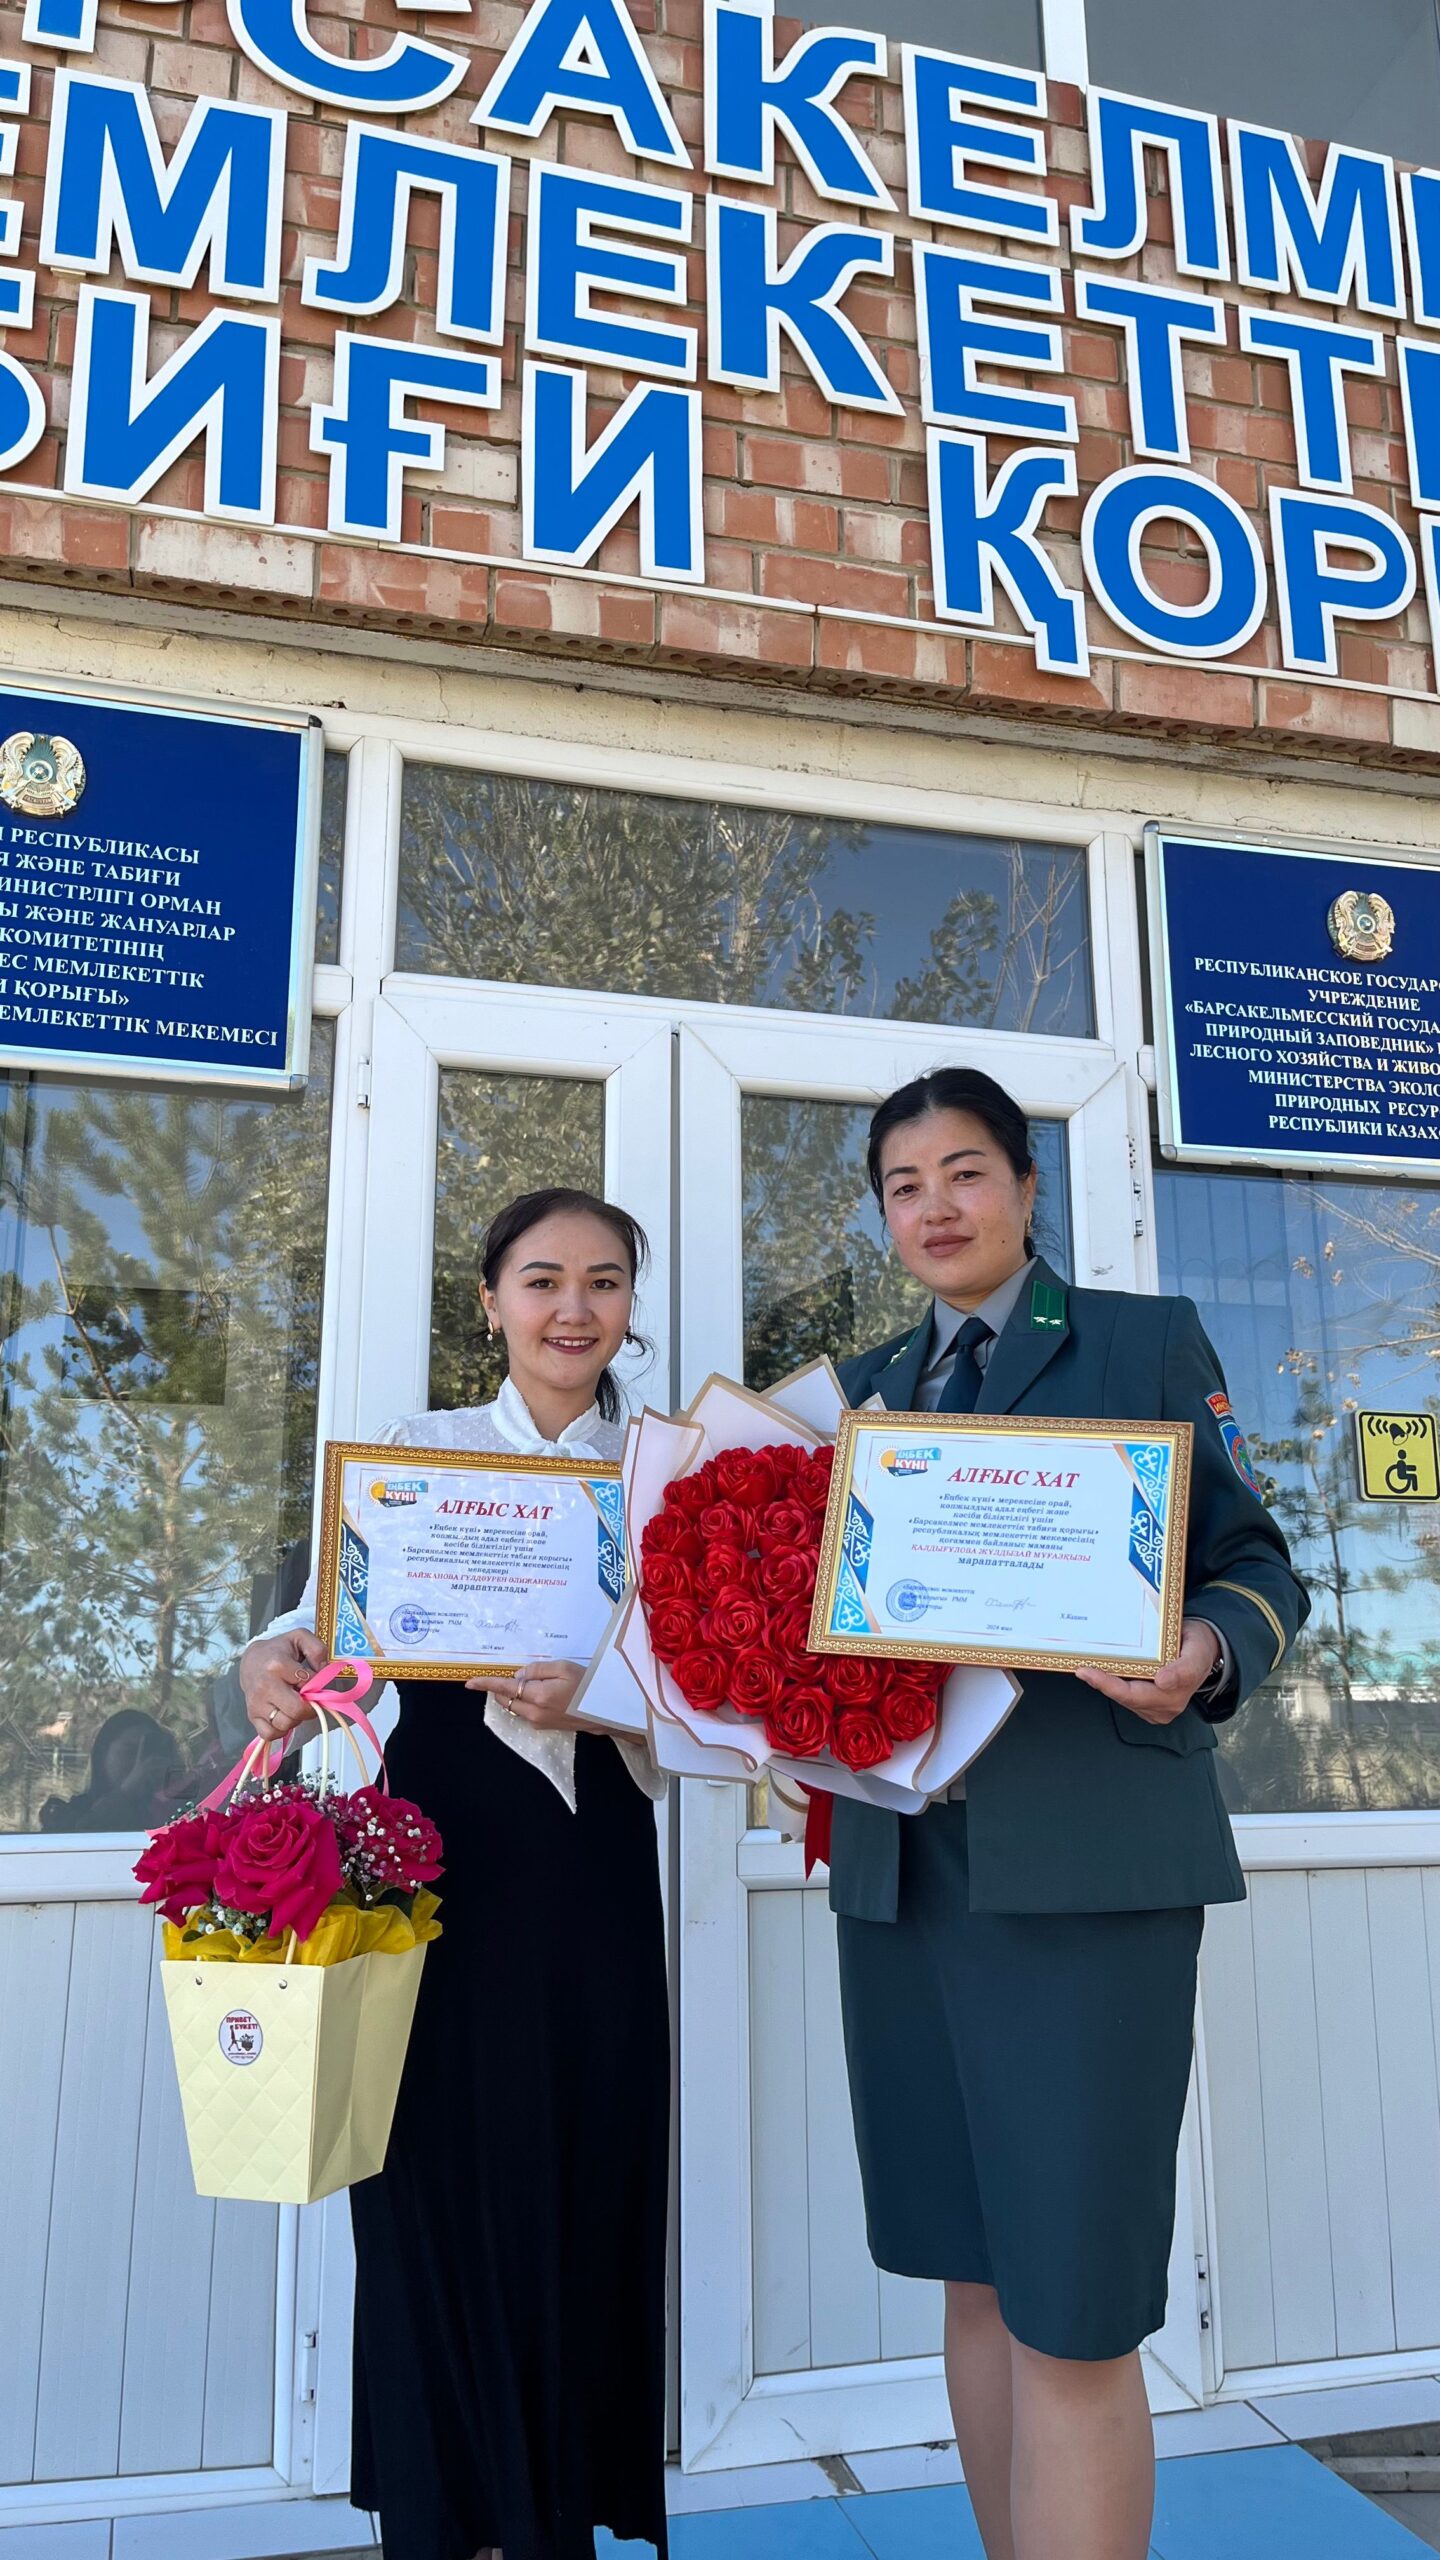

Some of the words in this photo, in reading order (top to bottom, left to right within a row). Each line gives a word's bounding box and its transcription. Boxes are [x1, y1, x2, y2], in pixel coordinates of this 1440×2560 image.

[22, 0, 1440, 329] САКЕЛМ
[926, 425, 1440, 697] ҚОР
[11, 828, 200, 864] РЕСПУБЛИКАСЫ
[16, 853, 85, 875] ЖӘНЕ
[91, 862, 181, 886] ТАБИҒИ
[140, 893, 221, 916] ОРМАН
[25, 904, 94, 926] ЖӘНЕ
[101, 912, 236, 941] ЖАНУАРЛАР
[34, 956, 205, 988] МЕМЛЕКЕТТІК
[1194, 957, 1363, 986] РЕСПУБЛИКАНСКОЕ
[1366, 973, 1440, 992] ГОСУДАР
[1185, 1000, 1374, 1028] «БАРСАКЕЛЬМЕССКИЙ
[1308, 989, 1421, 1011] УЧРЕЖДЕНИЕ
[155, 1020, 278, 1046] МЕКЕМЕСІ
[1205, 1023, 1312, 1044] ПРИРОДНЫЙ
[1316, 1032, 1434, 1054] ЗАПОВЕДНИК»
[1190, 1044, 1272, 1062] ЛЕСНОГО
[1276, 1050, 1373, 1070] ХОЗЯЙСТВА
[1377, 1058, 1389, 1072] И
[1248, 1070, 1386, 1093] МИНИСТЕРСТВА
[1275, 1094, 1381, 1114] ПРИРОДНЫХ
[1388, 1101, 1440, 1118] РЕСУР
[1268, 1115, 1382, 1136] РЕСПУБЛИКИ
[1386, 1123, 1440, 1140] КАЗАХ
[946, 1466, 1030, 1486] АЛҒЫС
[1032, 1471, 1080, 1488] ХАТ
[436, 1499, 509, 1517] АЛҒЫС
[513, 1504, 553, 1520] ХАТ
